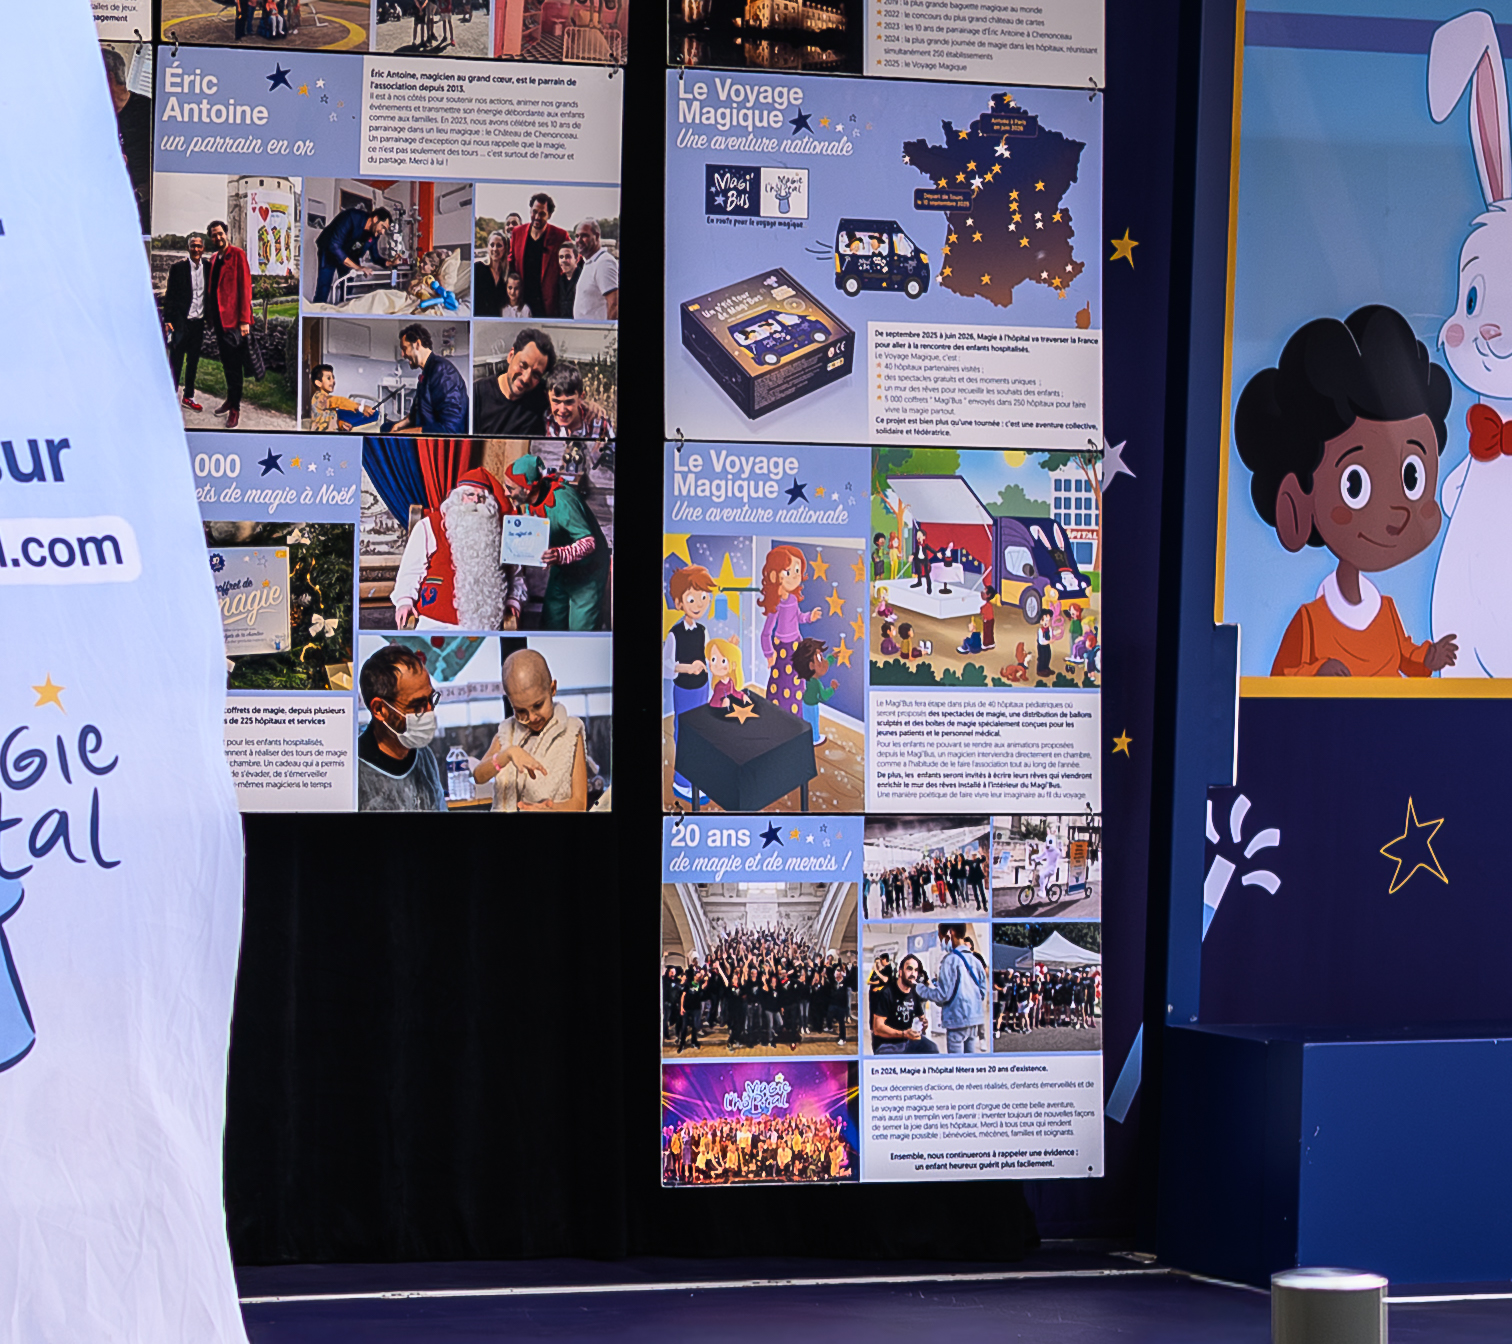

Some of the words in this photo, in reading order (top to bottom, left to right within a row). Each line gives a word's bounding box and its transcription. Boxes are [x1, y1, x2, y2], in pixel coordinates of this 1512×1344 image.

[165, 61, 218, 94] Éric
[371, 69, 384, 78] Éric
[468, 75, 491, 83] grand
[419, 83, 445, 93] depuis
[678, 78, 708, 99] Le
[715, 78, 803, 107] Voyage
[162, 97, 268, 125] Antoine
[678, 102, 784, 131] Magique
[161, 136, 186, 151] un
[186, 135, 263, 157] parrain
[267, 139, 289, 154] en
[293, 140, 314, 156] or
[677, 128, 708, 148] Une
[711, 129, 778, 152] aventure
[780, 135, 853, 156] nationale
[674, 451, 703, 473] Le
[710, 449, 799, 476] Voyage
[220, 482, 242, 503] de
[244, 487, 297, 514] magie
[300, 486, 314, 504] à
[316, 484, 356, 505] Noël
[674, 476, 779, 503] Magique
[672, 502, 703, 521] Une
[706, 504, 774, 522] aventure
[775, 504, 848, 524] nationale
[255, 717, 286, 726] hôpitaux
[297, 717, 325, 725] services
[263, 707, 287, 715] magie,
[288, 707, 312, 715] depuis
[314, 707, 346, 715] plusieurs
[671, 824, 700, 847] 20
[707, 829, 750, 847] ans
[670, 851, 690, 871] de
[692, 854, 742, 881] magie
[745, 853, 759, 871] et
[763, 852, 783, 870] de
[785, 854, 837, 871] mercis
[841, 851, 852, 870] !
